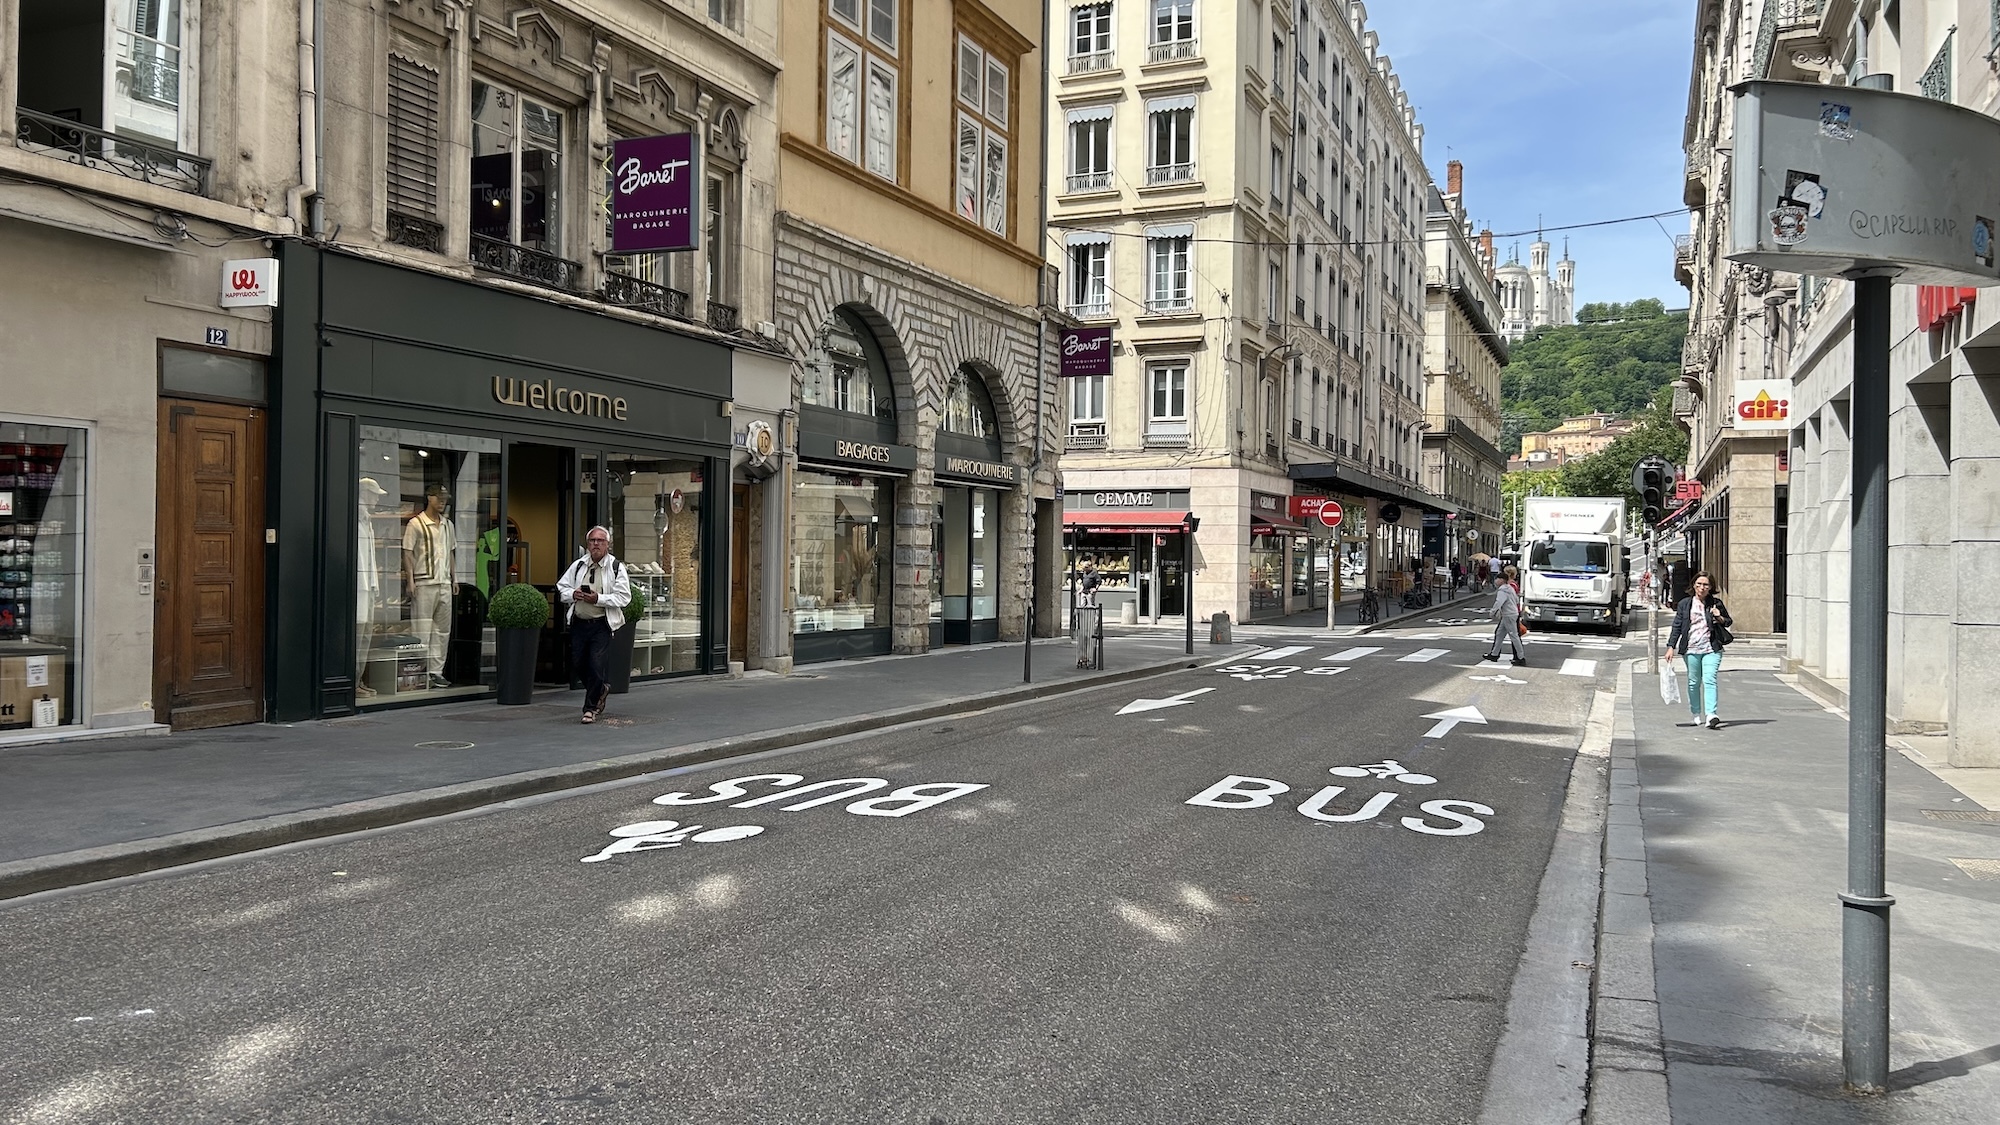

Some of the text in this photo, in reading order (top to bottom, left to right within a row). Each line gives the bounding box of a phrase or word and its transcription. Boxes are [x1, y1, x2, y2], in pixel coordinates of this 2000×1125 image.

[617, 157, 690, 195] Barret
[616, 207, 689, 220] MAROQUINERIE
[632, 220, 671, 230] BAGAGE
[209, 329, 224, 345] 12
[1062, 334, 1110, 356] Barret
[492, 375, 628, 421] welcome
[736, 433, 745, 446] 10
[836, 440, 891, 463] BAGAGES
[946, 457, 1014, 481] MAROQUINERIE
[1093, 492, 1154, 506] GEMME
[1301, 499, 1326, 507] ACHAT
[1216, 664, 1351, 676] BUS
[652, 773, 991, 817] BUS
[1184, 774, 1495, 837] BUS
